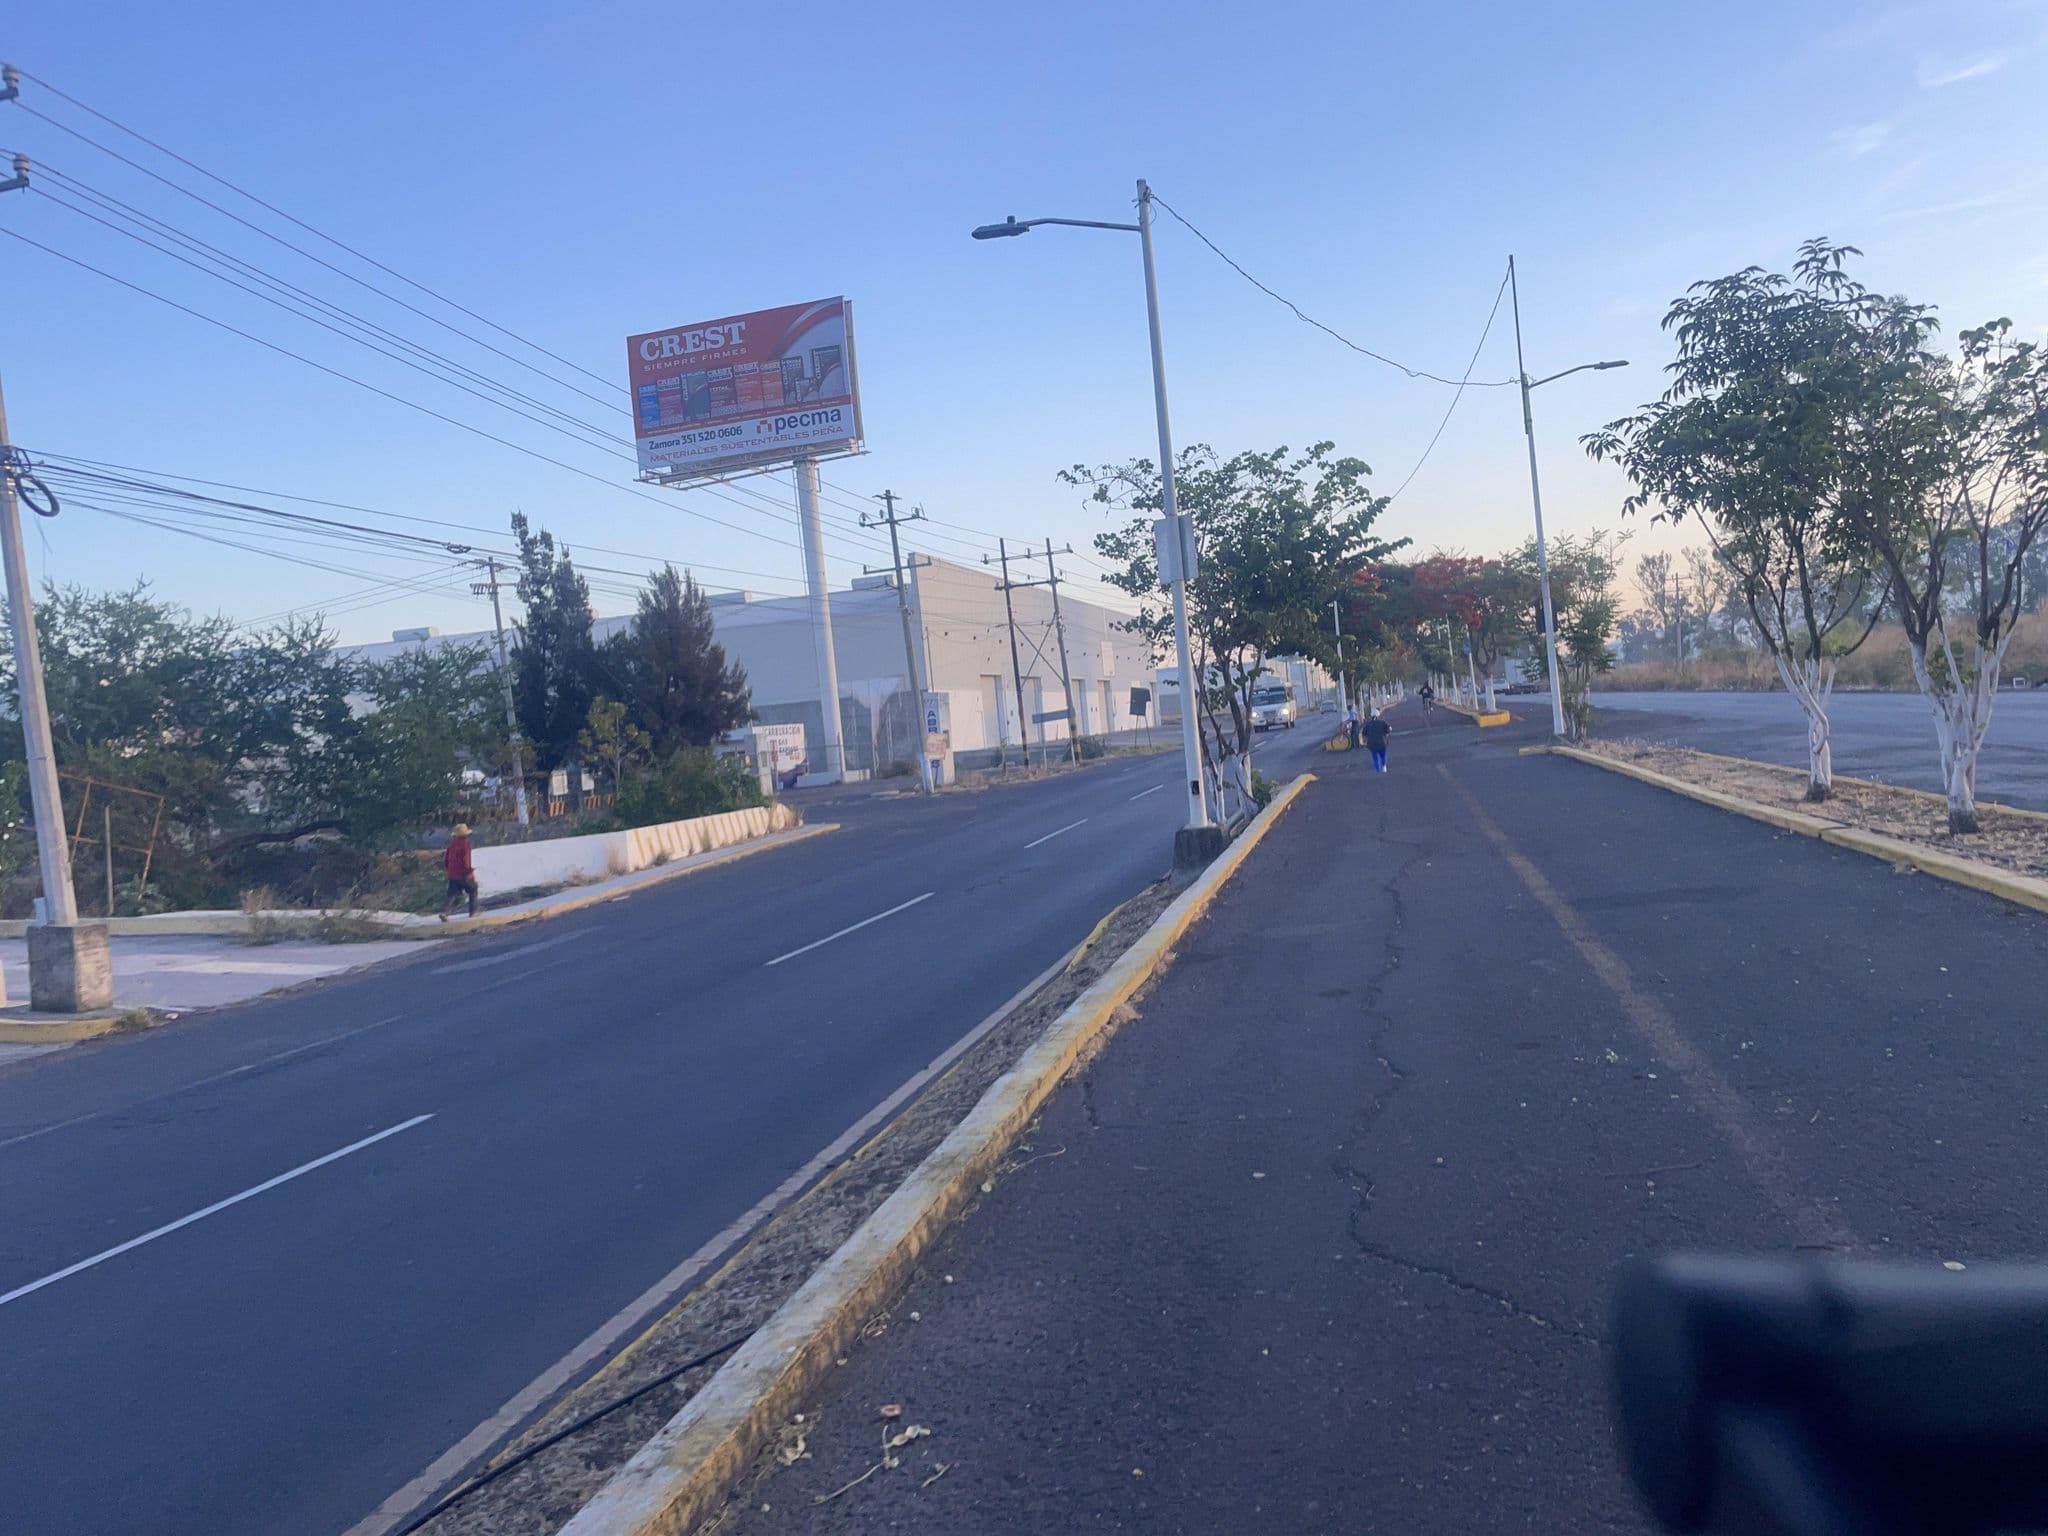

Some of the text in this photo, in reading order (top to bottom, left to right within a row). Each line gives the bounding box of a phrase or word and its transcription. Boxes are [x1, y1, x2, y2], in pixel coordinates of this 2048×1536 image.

[640, 321, 746, 361] CREST
[643, 347, 747, 371] SIEMPRE FIRMES
[774, 408, 842, 435] pecma
[648, 425, 743, 450] Zamora 351 520 0606
[650, 426, 844, 463] MATERIALES SUSTENTABLES PEÑA
